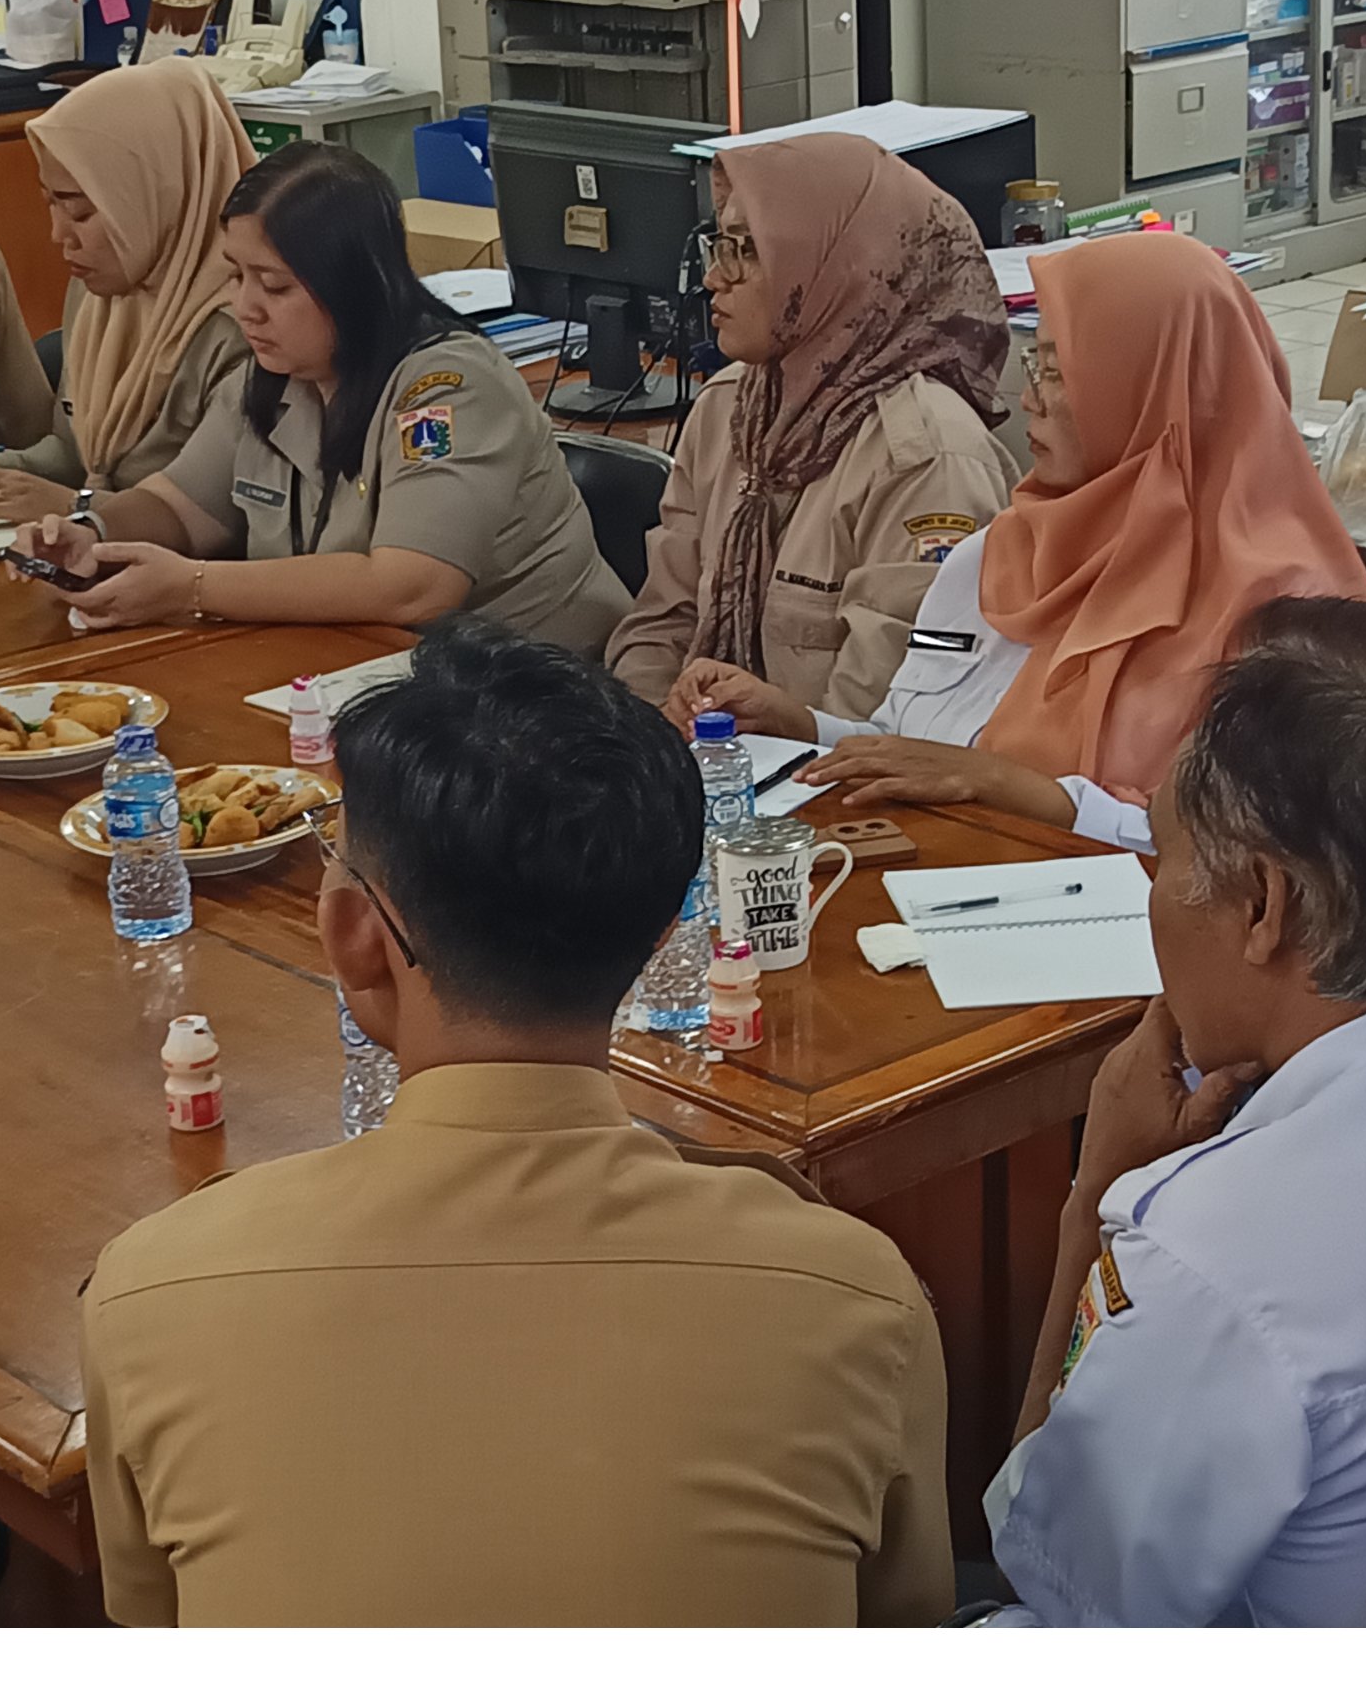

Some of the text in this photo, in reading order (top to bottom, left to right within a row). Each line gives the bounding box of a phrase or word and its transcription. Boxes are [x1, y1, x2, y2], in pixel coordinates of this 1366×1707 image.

[746, 856, 799, 887] good
[750, 907, 791, 924] TAKE
[744, 925, 800, 953] TIME
